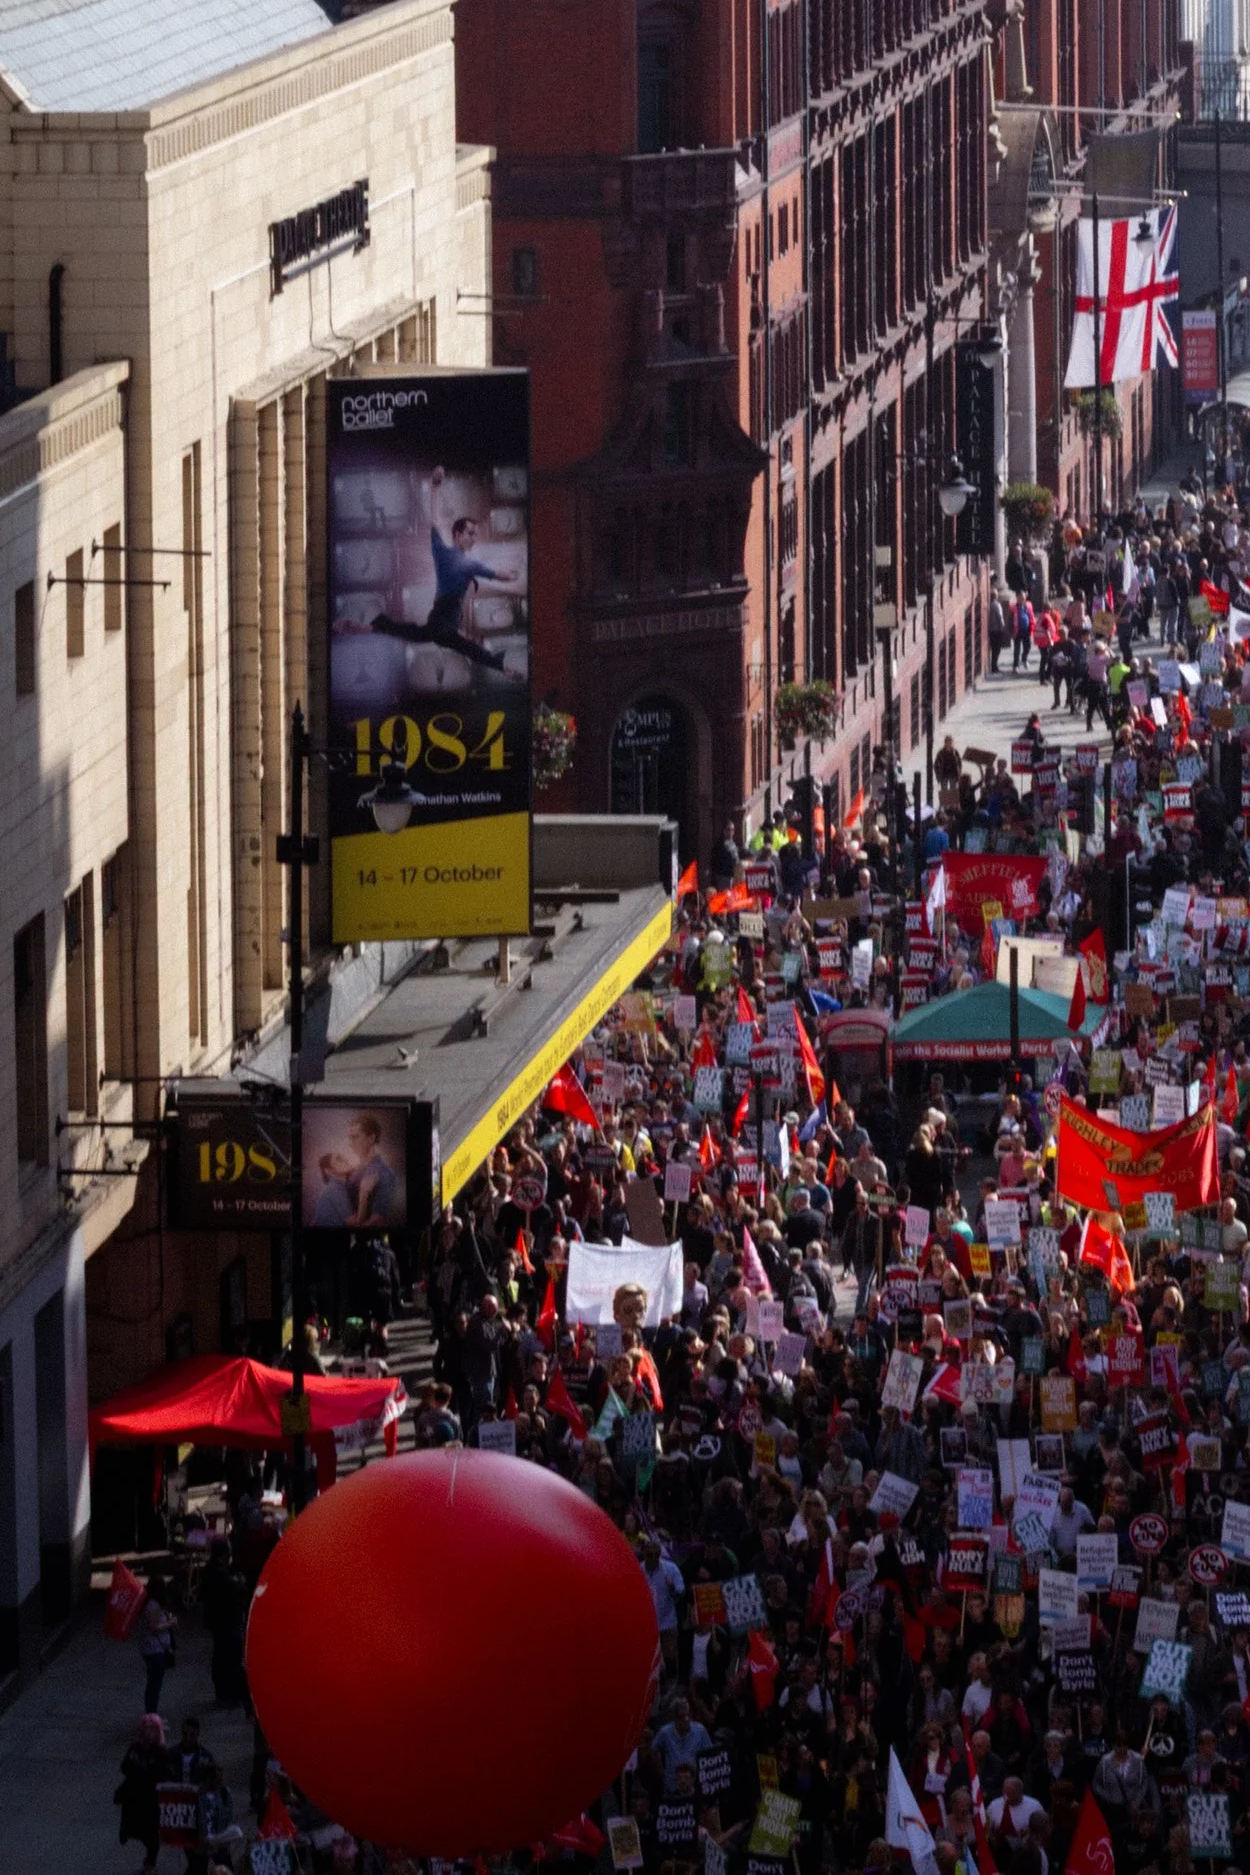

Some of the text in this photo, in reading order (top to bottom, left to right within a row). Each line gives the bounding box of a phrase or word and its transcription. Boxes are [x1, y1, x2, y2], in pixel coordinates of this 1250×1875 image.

[342, 389, 428, 411] northern
[342, 405, 395, 427] ballet
[347, 710, 513, 777] 1984
[461, 791, 502, 805] Watkins
[358, 868, 378, 887] 14
[401, 865, 418, 885] 17
[423, 864, 504, 884] October
[914, 1043, 932, 1056] the
[933, 1043, 974, 1057] Socialist
[1021, 1040, 1048, 1053] Party
[197, 1139, 285, 1185] 198
[211, 1199, 224, 1211] 14
[235, 1199, 246, 1211] 17
[247, 1197, 292, 1212] October
[1145, 1193, 1176, 1206] CUT
[1149, 1215, 1175, 1229] NOT
[1115, 1336, 1137, 1350] JOBS
[1138, 1521, 1158, 1531] NO
[1135, 1530, 1161, 1543] CUTS
[949, 1550, 984, 1562] TORY
[1080, 1545, 1115, 1556] Refugees
[1201, 1552, 1219, 1562] NO
[1080, 1556, 1115, 1565] welcome
[1088, 1564, 1106, 1573] here
[1043, 1580, 1075, 1592] Refugees
[1051, 1600, 1067, 1610] here
[1215, 1591, 1248, 1605] Don't
[1153, 1640, 1192, 1656] CUT
[1059, 1654, 1094, 1668] Don't
[1148, 1654, 1190, 1669] WAR
[1058, 1666, 1096, 1679] Bomb
[1143, 1668, 1187, 1686] NOT
[1062, 1677, 1096, 1692] Syria
[698, 1750, 728, 1769] Don't
[698, 1763, 732, 1781] Bomb
[702, 1777, 732, 1796] Syria
[159, 1801, 197, 1815] TORY
[658, 1803, 695, 1816] Don't
[1187, 1794, 1227, 1810] CUT
[158, 1813, 197, 1829] RULE
[656, 1816, 696, 1830] Bomb
[1189, 1810, 1228, 1825] WAR
[658, 1829, 694, 1845] Syria
[1190, 1824, 1231, 1843] NOT
[250, 1841, 289, 1856] CUT
[747, 1858, 785, 1874] Don't
